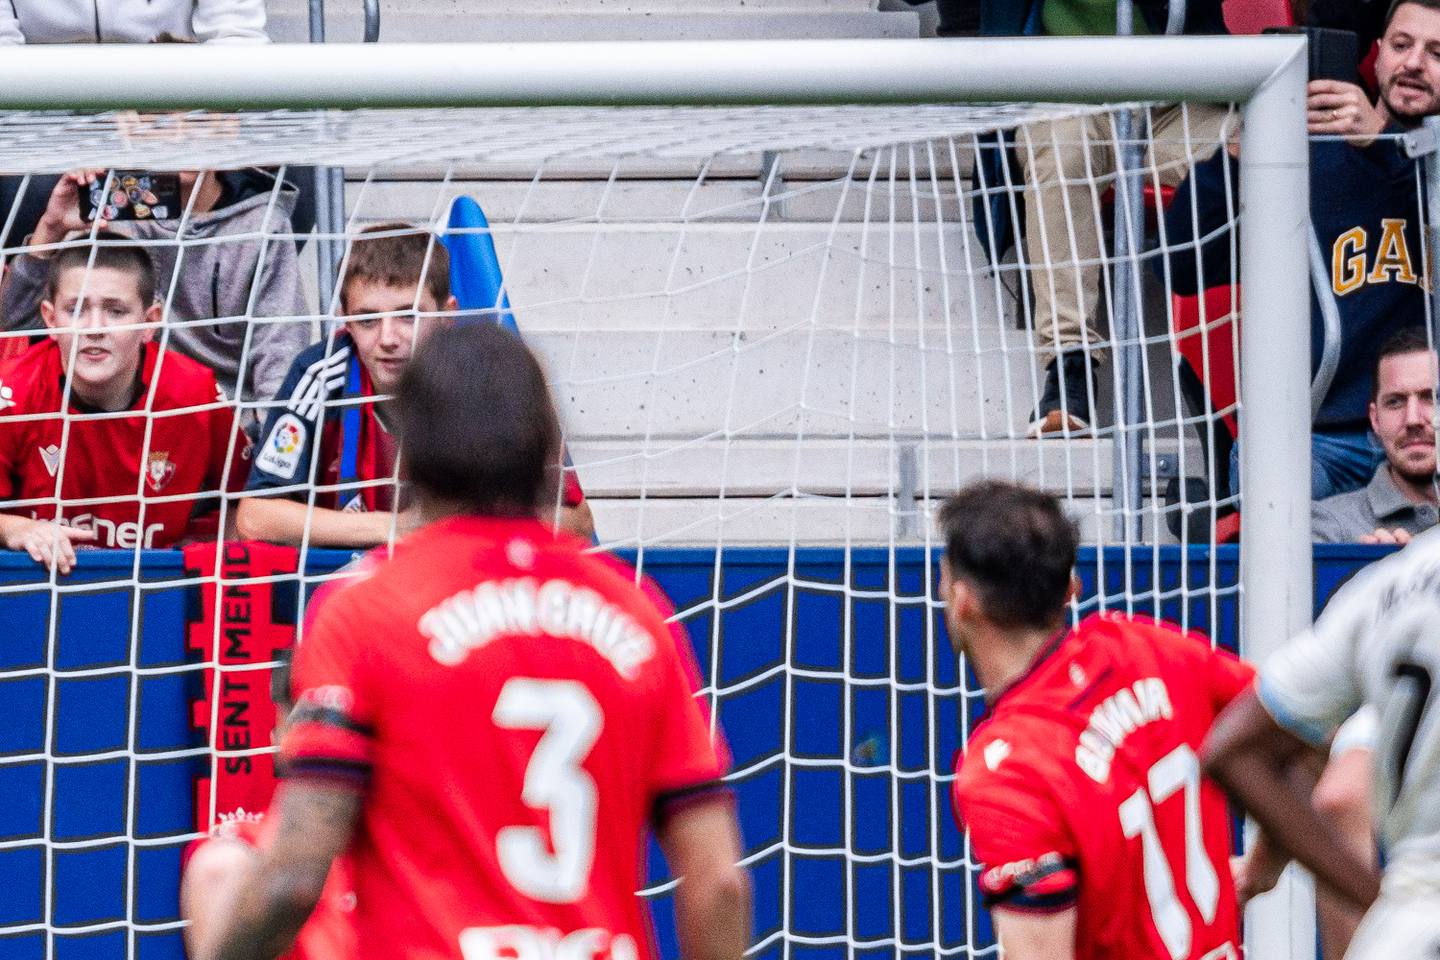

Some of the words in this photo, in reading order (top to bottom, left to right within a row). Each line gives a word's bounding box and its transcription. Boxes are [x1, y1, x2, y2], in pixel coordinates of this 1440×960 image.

[1332, 218, 1435, 296] GA
[31, 510, 165, 549] sner
[490, 675, 606, 904] 3
